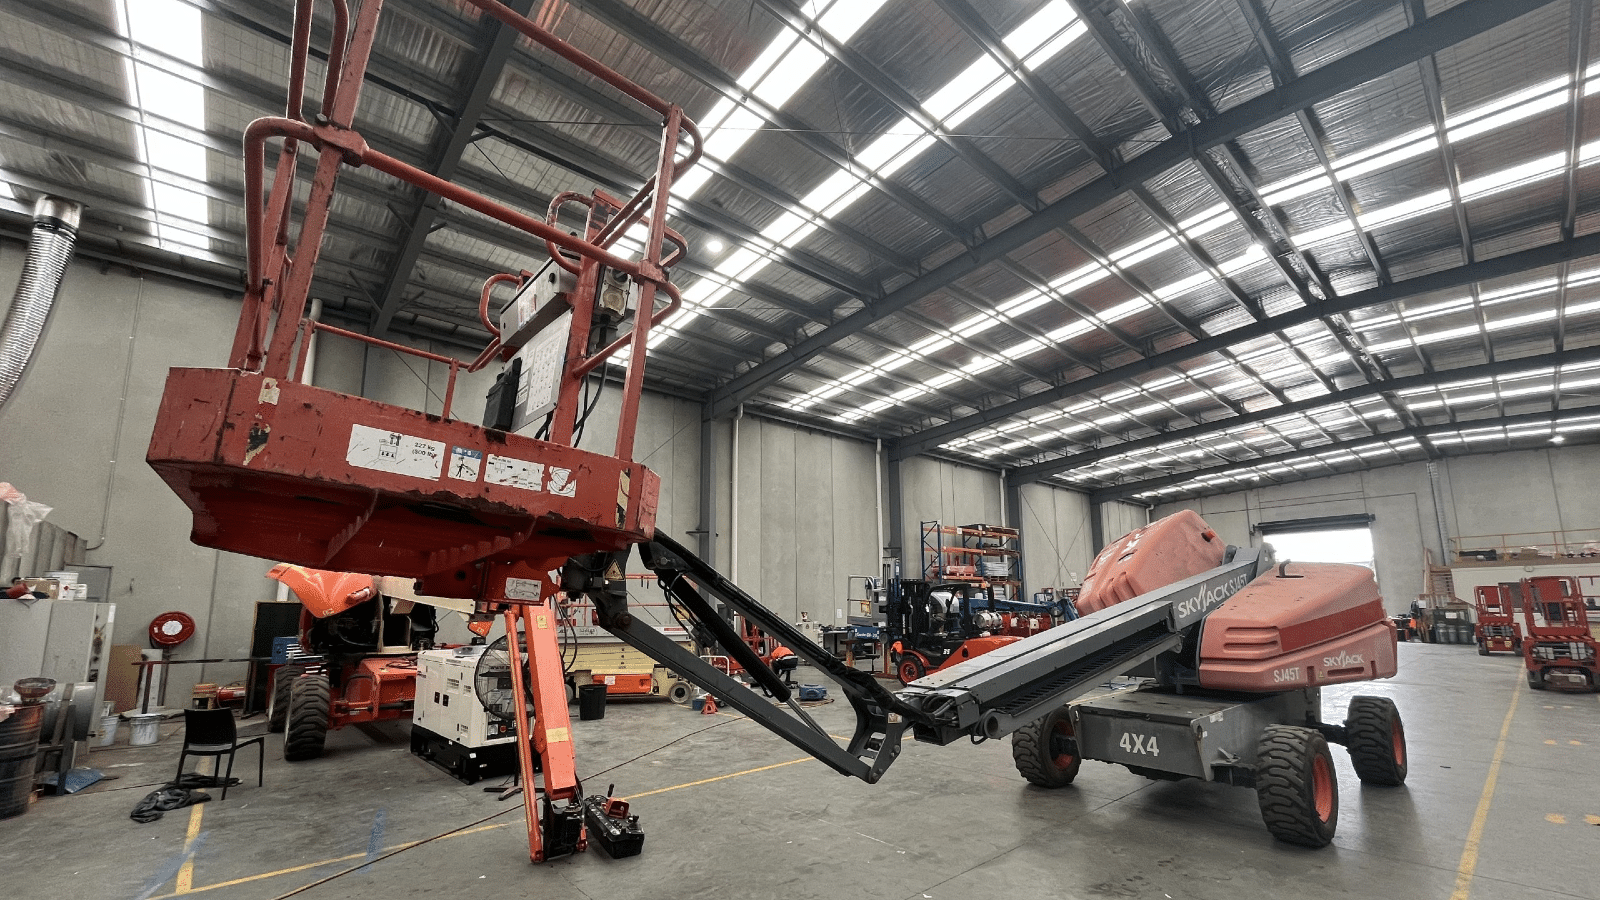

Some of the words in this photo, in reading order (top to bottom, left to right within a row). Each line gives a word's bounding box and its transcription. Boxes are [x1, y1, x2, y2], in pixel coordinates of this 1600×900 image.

[1177, 582, 1230, 619] SKYJACK
[1323, 650, 1365, 668] SKYJACK
[1273, 667, 1300, 683] SJ45T
[1119, 732, 1160, 757] 4X4
